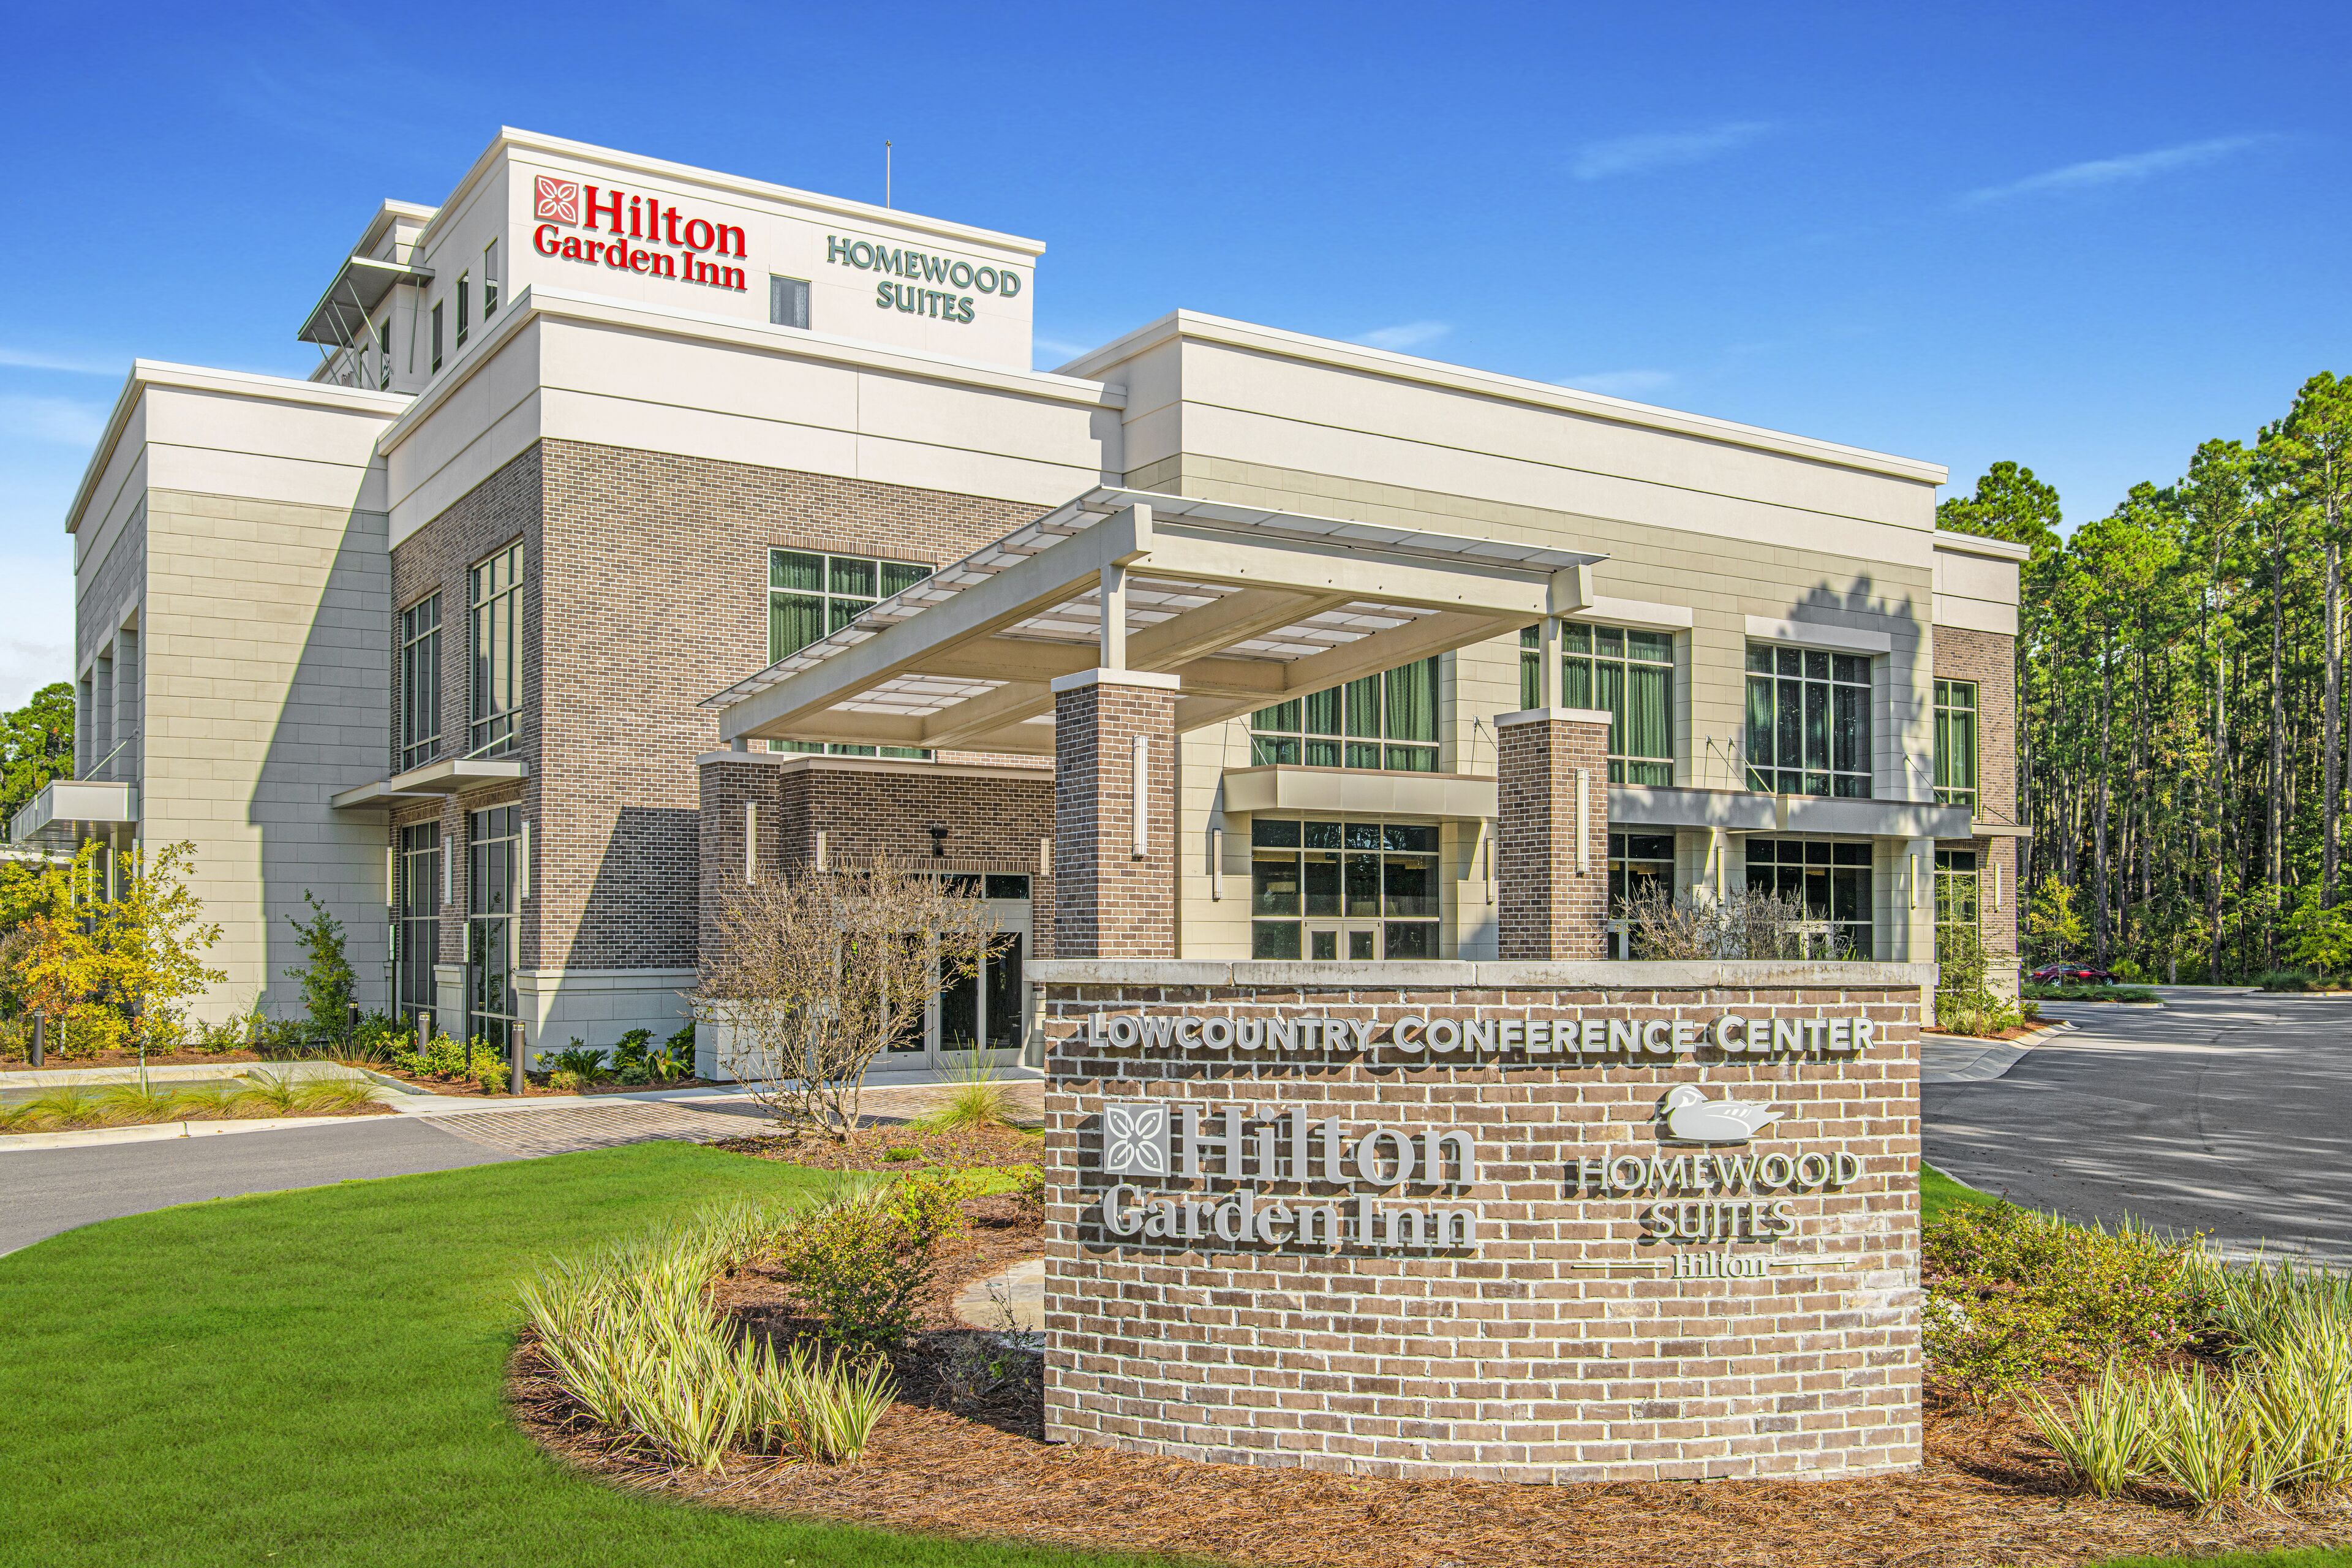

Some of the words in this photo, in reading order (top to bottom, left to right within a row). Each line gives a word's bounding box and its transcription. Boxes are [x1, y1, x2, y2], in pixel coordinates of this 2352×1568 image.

[583, 185, 748, 258] Hilton
[533, 224, 677, 279] Garden
[681, 251, 748, 291] Inn
[827, 235, 1021, 298] HOMEWOOD
[876, 281, 975, 323] SUITES
[1088, 1012, 1378, 1050] LOWCOUNTRY
[1393, 1016, 1697, 1054] CONFERENCE
[1714, 1014, 1876, 1052] CENTER
[1178, 1104, 1480, 1186] Hilton
[1577, 1152, 1862, 1190] HOMEWOOD
[1102, 1183, 1343, 1245] Garden
[1353, 1192, 1477, 1249] Inn
[1650, 1200, 1796, 1237] SUITES
[1673, 1250, 1770, 1278] Hilton
